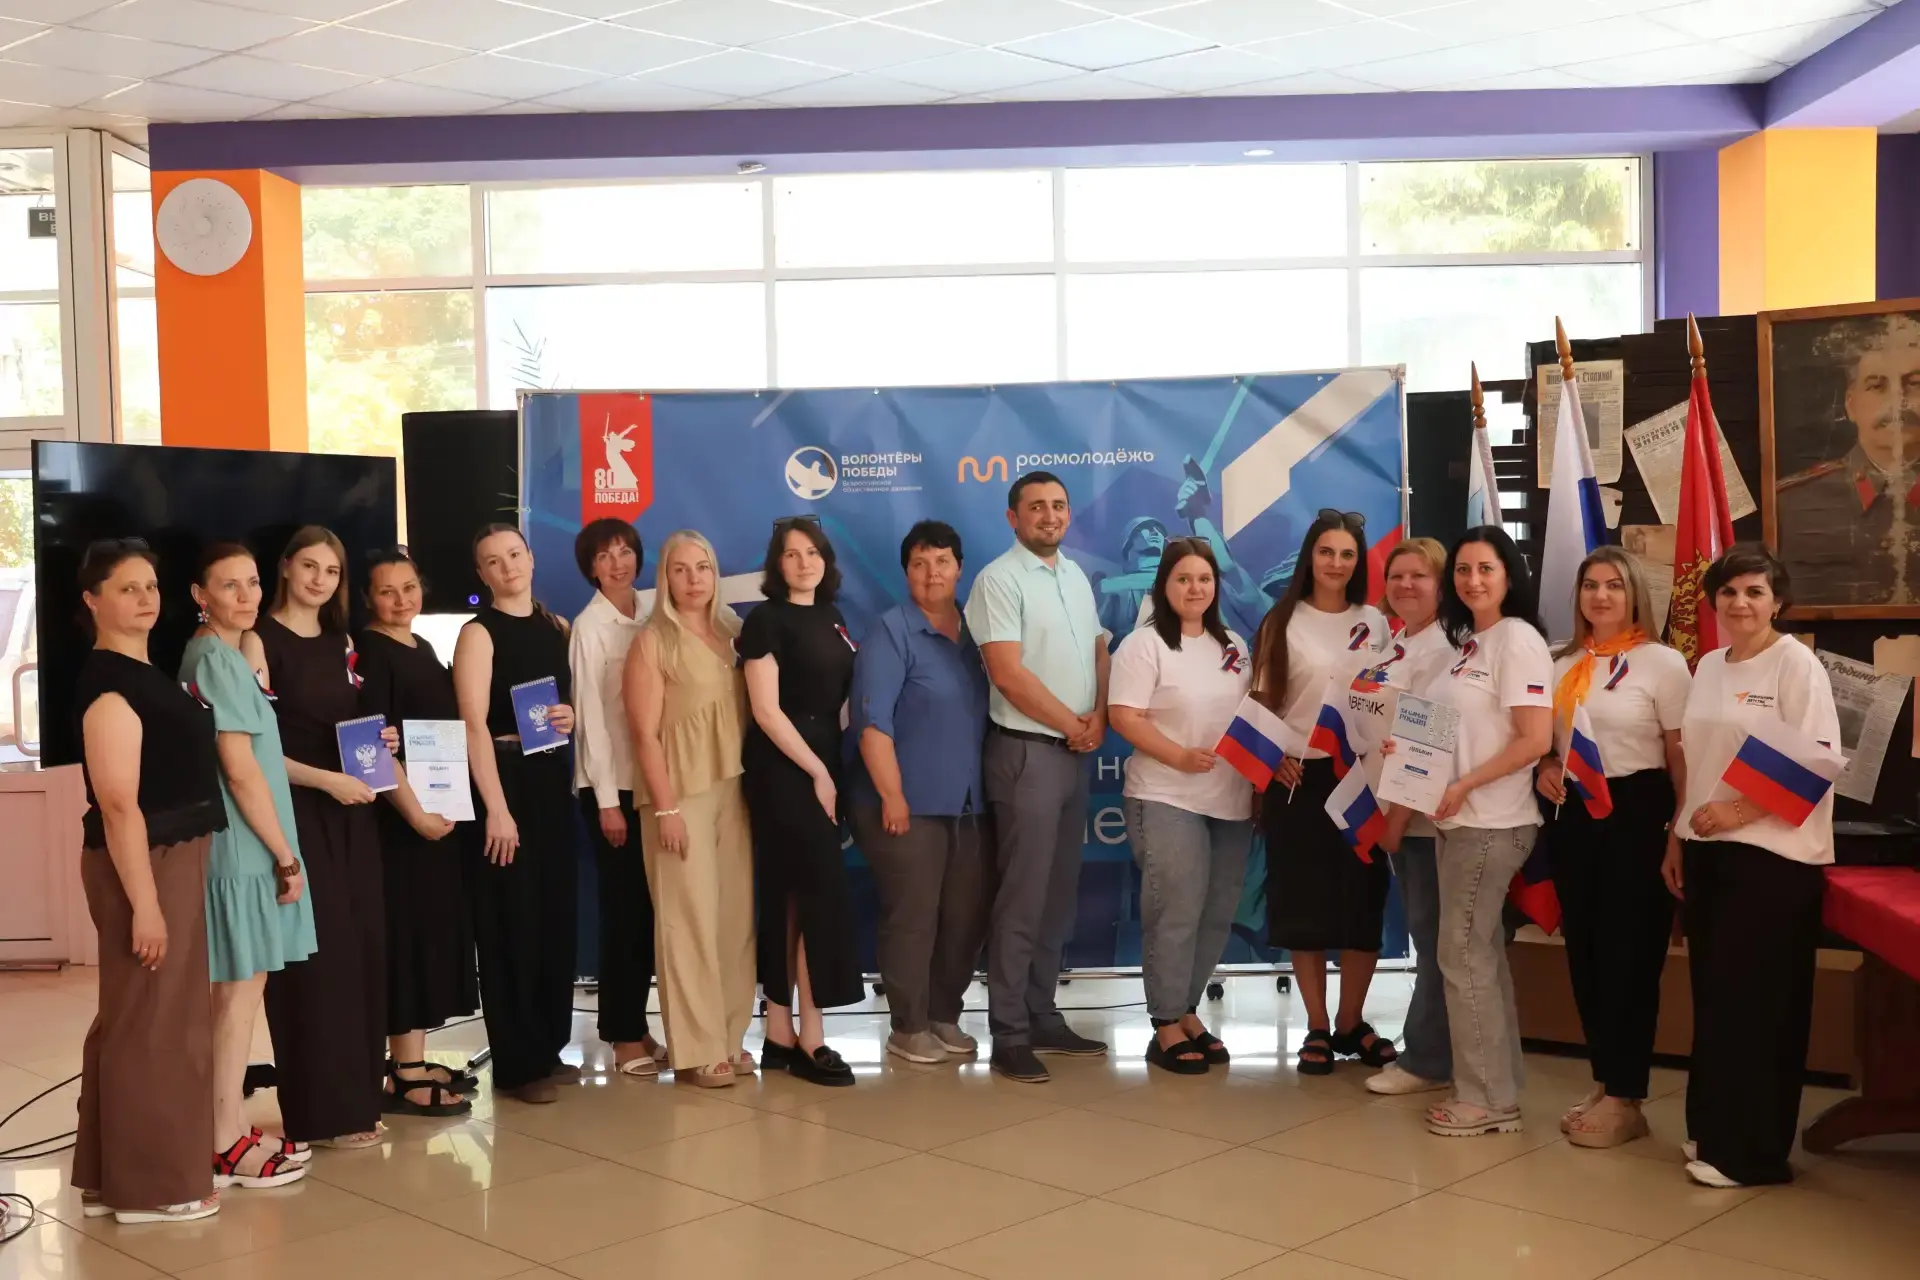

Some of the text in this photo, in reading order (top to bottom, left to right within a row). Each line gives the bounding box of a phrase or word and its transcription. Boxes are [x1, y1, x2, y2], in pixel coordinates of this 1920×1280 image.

[841, 452, 922, 465] ВОЛОНТЁРЫ
[1016, 448, 1155, 472] росмолодёжь
[594, 468, 614, 489] 80
[842, 467, 897, 478] ПОБЕДЫ
[594, 492, 639, 504] ПОБЕДА!
